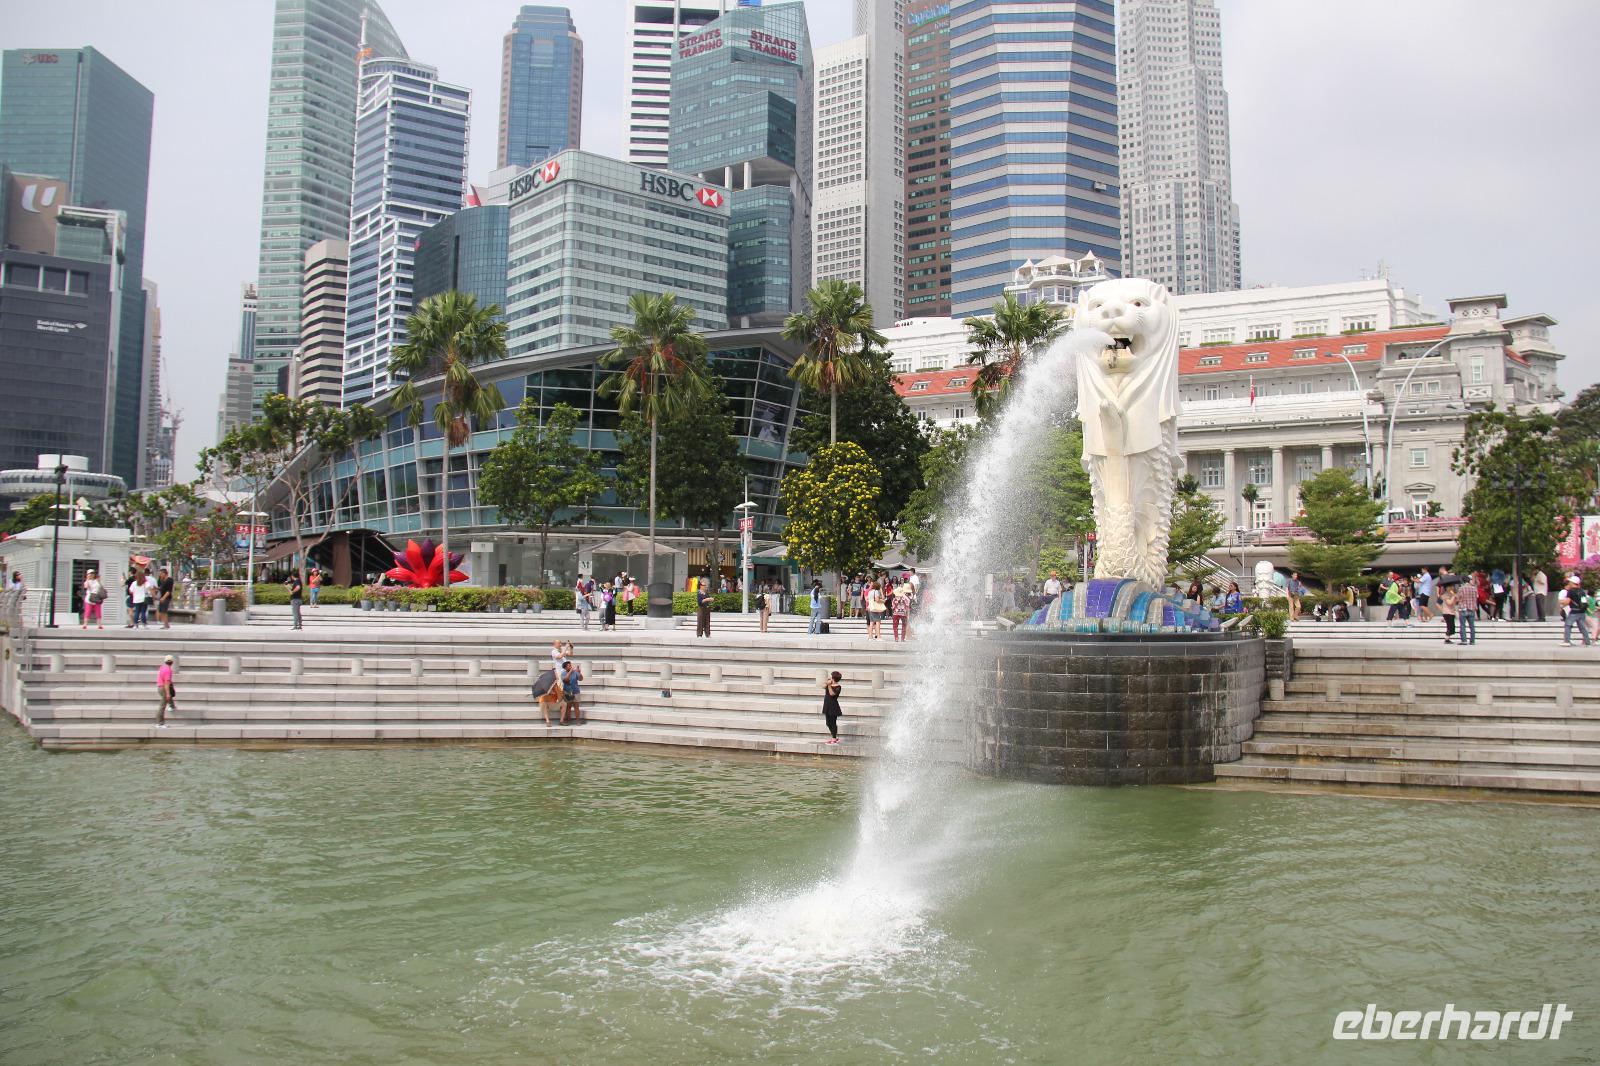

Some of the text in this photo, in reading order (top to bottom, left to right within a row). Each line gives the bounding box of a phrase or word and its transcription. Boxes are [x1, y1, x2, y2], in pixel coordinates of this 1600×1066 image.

[679, 28, 721, 49] STRAITS
[679, 38, 723, 58] TRADING
[750, 30, 797, 51] STRAITS
[748, 39, 797, 61] TRADING
[508, 168, 541, 201] HSBC
[640, 171, 694, 201] HSBC
